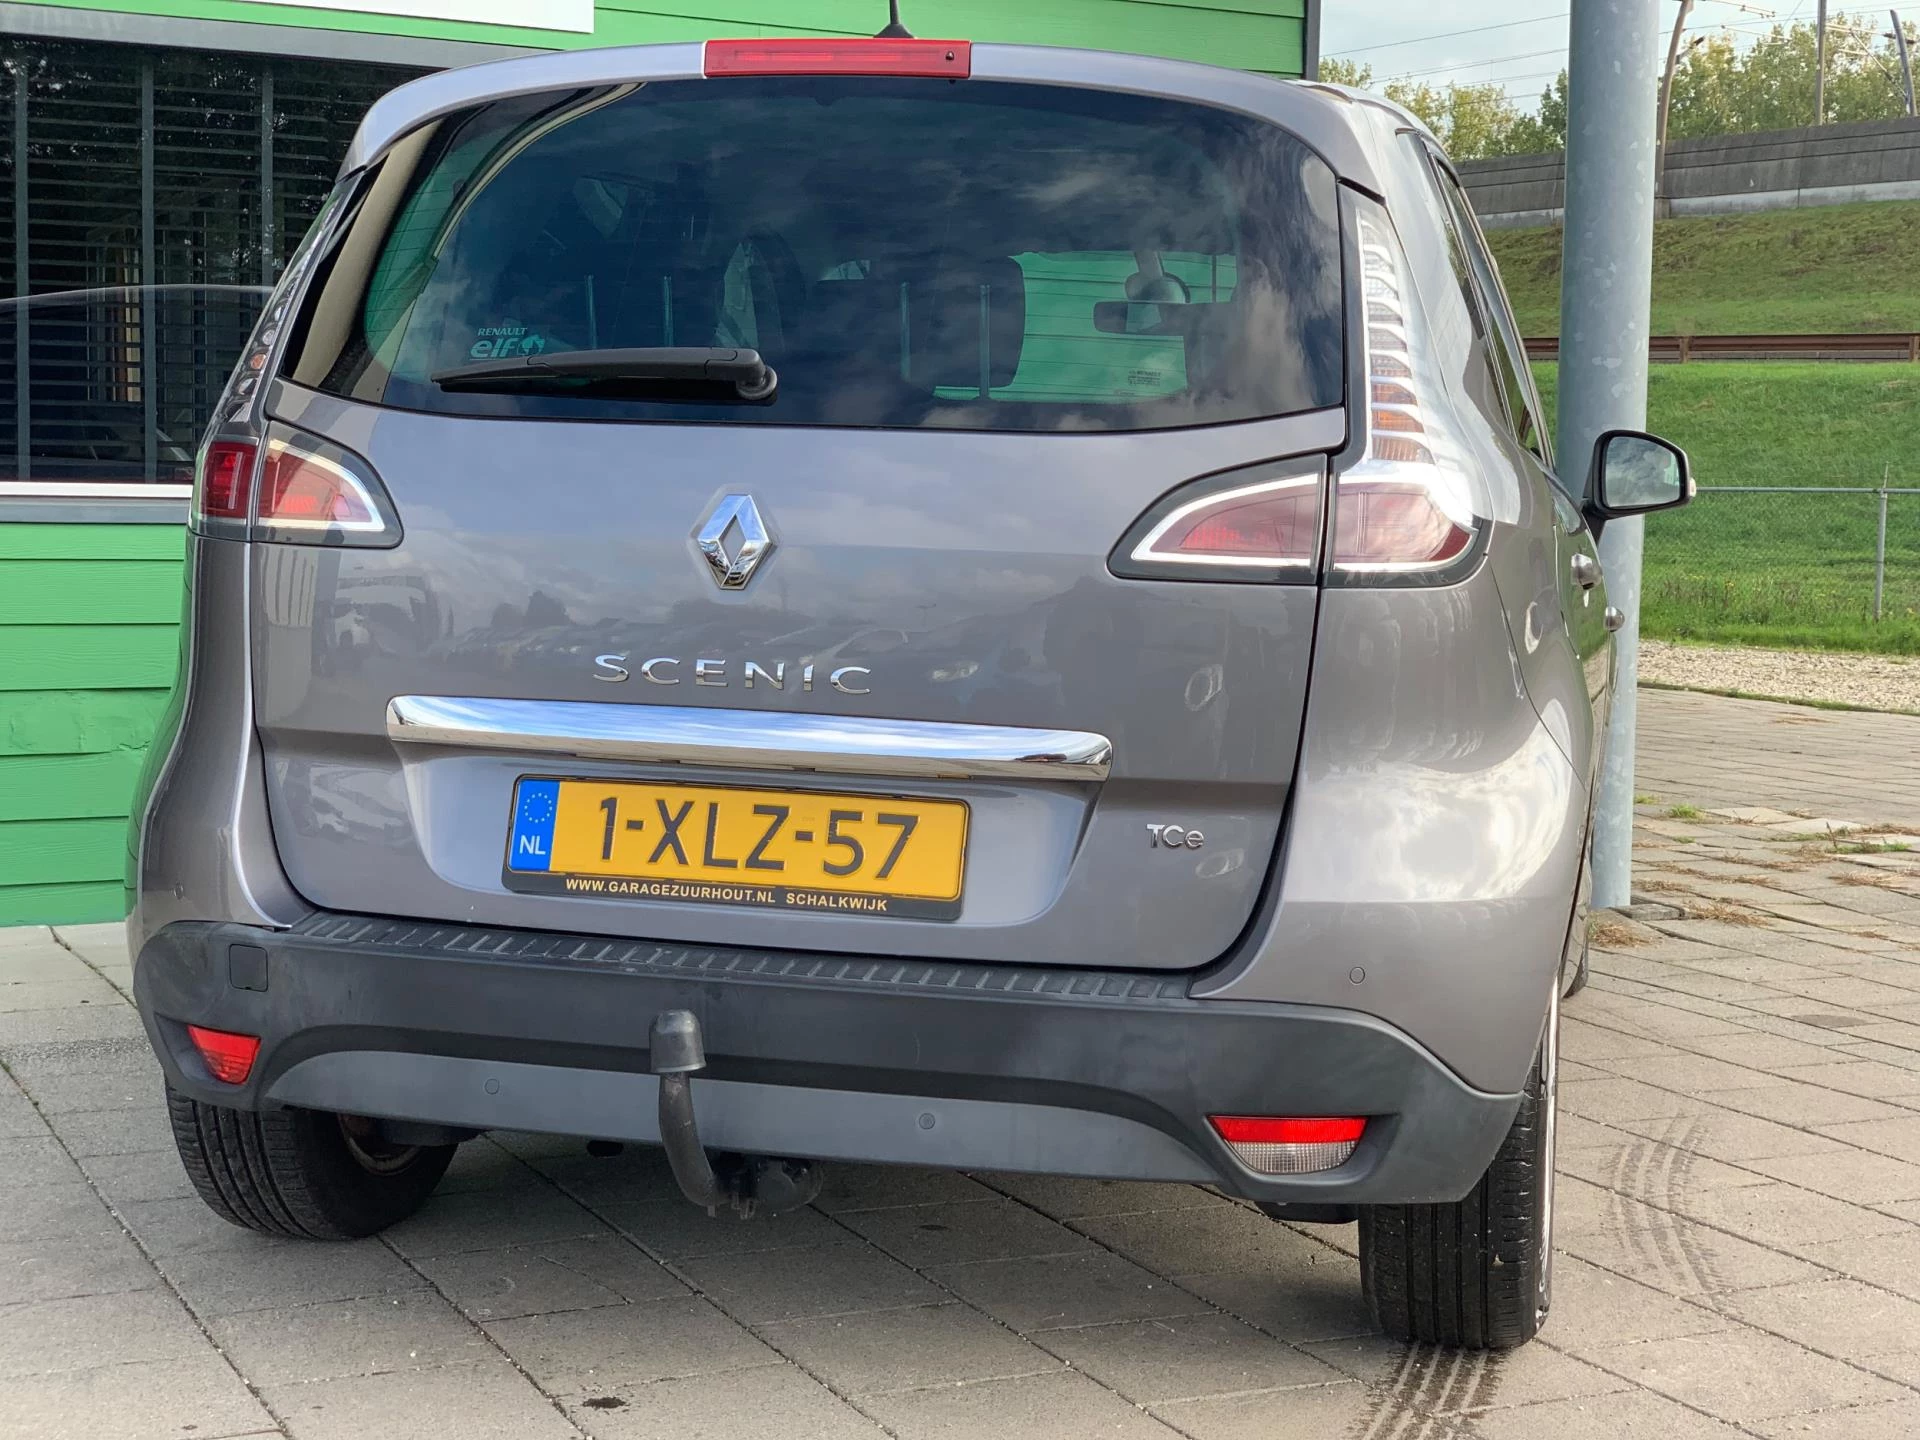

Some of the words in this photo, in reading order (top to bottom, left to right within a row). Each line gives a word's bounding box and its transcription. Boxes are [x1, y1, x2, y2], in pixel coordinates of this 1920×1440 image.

[477, 327, 528, 337] RENAULT
[470, 337, 520, 358] elf
[592, 654, 871, 694] SCENIC
[519, 834, 546, 855] NL
[599, 796, 919, 879] 1-XLZ-57
[1145, 823, 1204, 849] TCe
[566, 878, 776, 903] WWW.GARAGEZUURHOUT.NL
[786, 892, 887, 911] SCHALKWIJK
